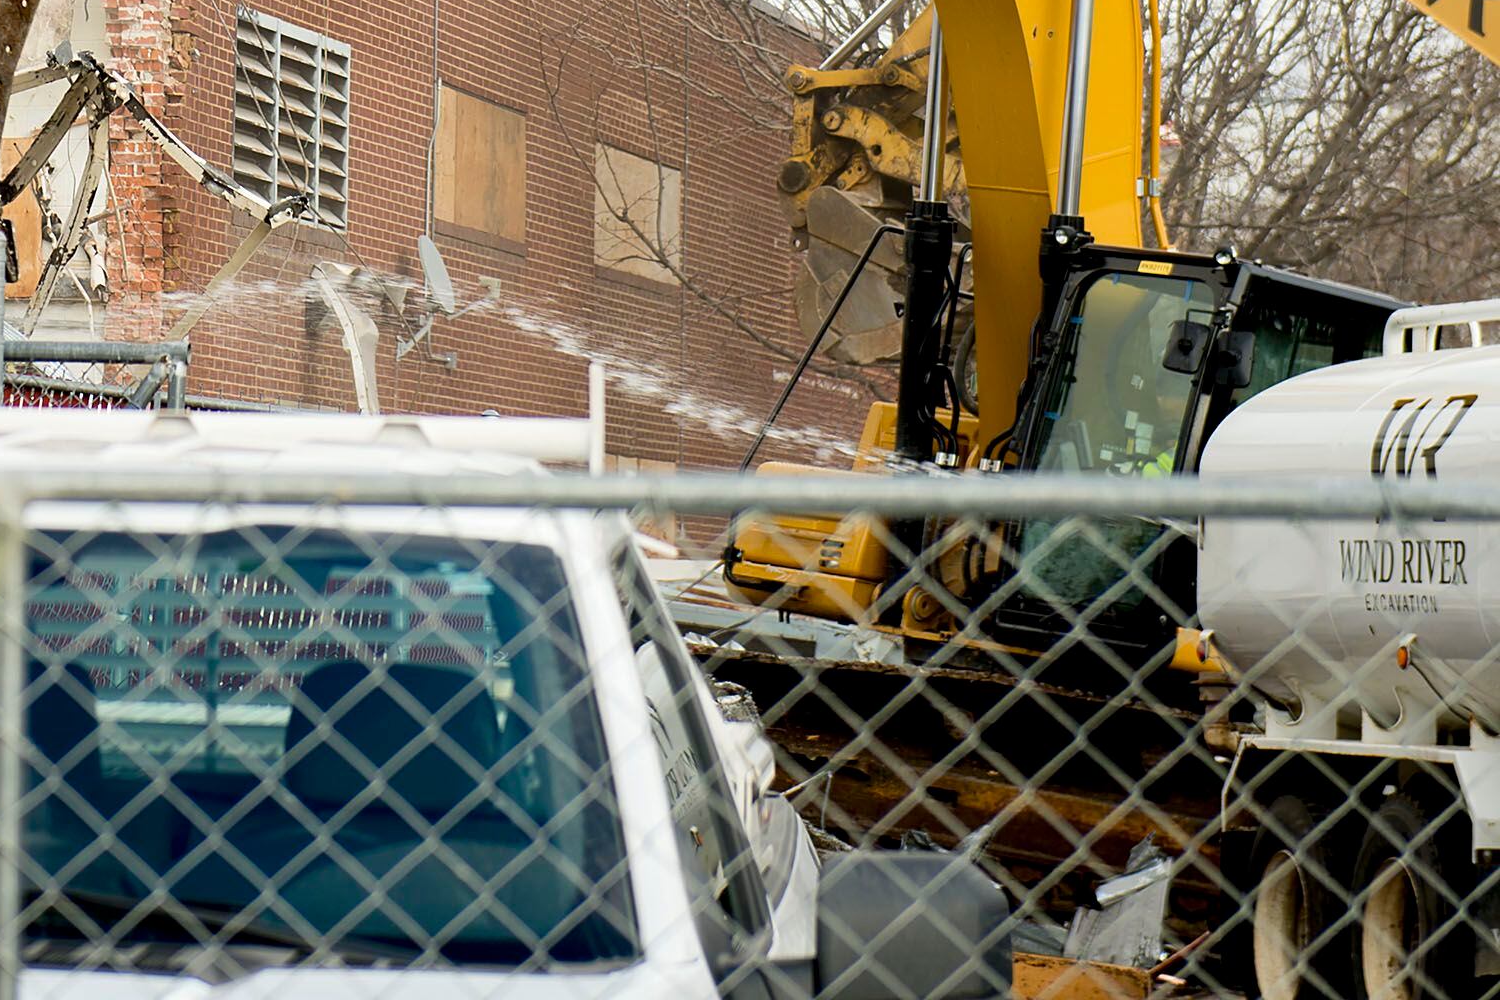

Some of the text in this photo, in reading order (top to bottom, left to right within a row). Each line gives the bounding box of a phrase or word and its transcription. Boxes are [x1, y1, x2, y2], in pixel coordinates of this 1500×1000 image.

[1339, 540, 1467, 584] WIND RIVER
[1364, 593, 1438, 613] EXCAVATION
